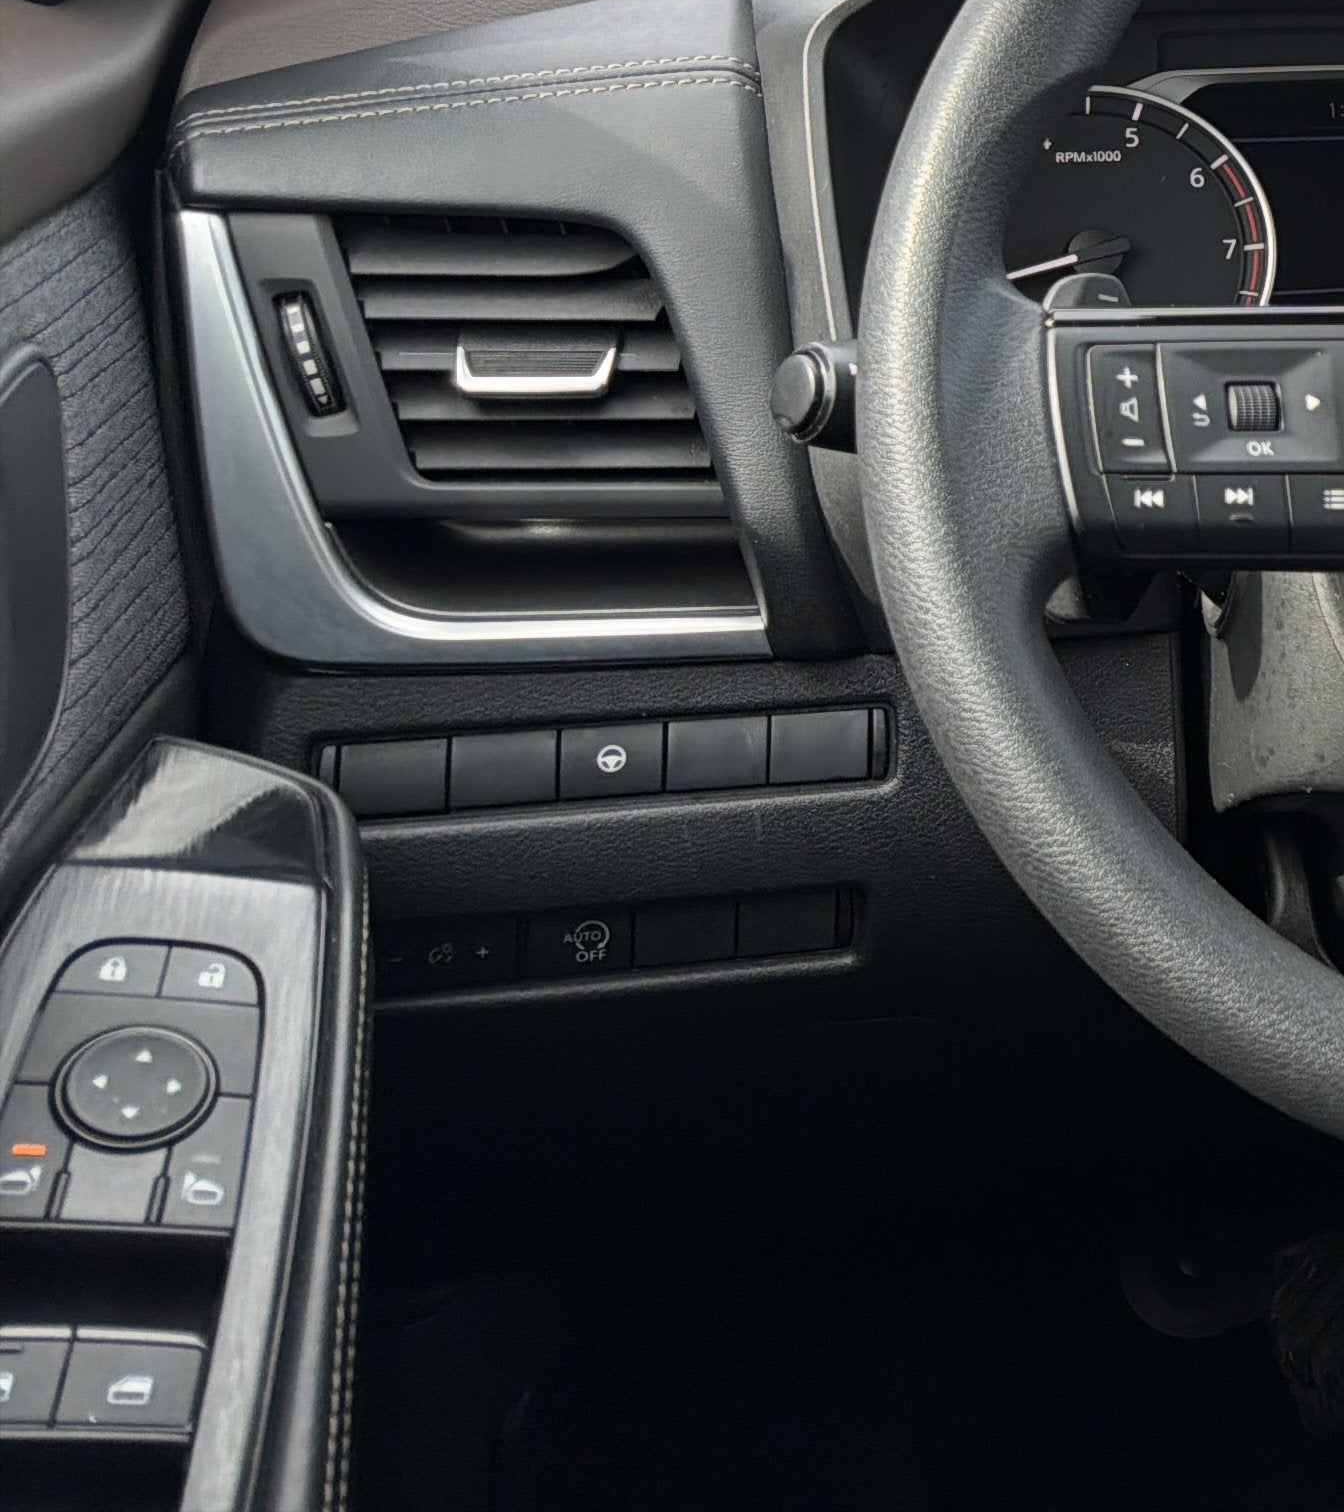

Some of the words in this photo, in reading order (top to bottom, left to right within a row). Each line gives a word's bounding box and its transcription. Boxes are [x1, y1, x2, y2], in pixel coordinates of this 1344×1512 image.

[1124, 127, 1140, 148] 5
[1055, 150, 1122, 164] RPMx1000
[1189, 167, 1206, 189] 6
[1222, 239, 1237, 260] 7
[1246, 440, 1275, 457] OK
[563, 930, 601, 943] AUTO
[575, 949, 607, 962] OFF
